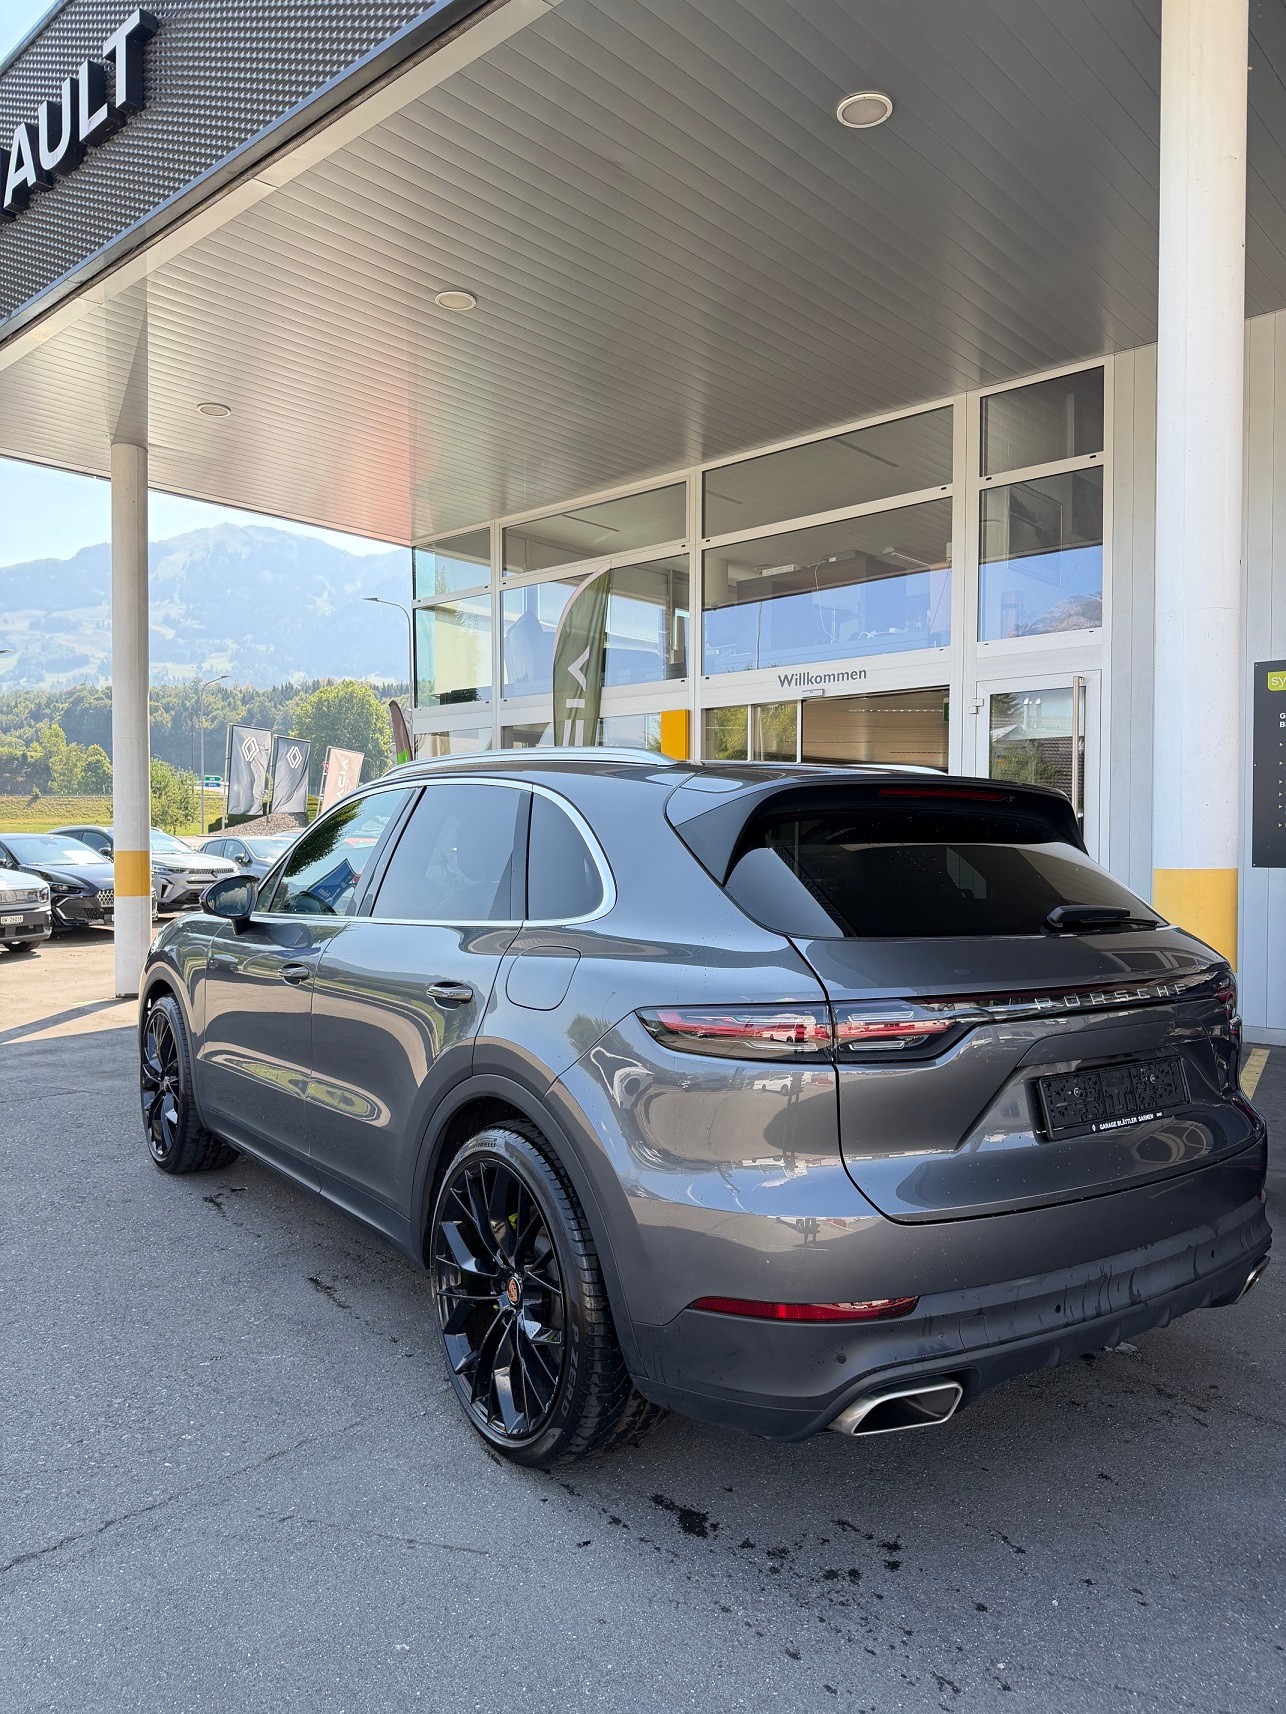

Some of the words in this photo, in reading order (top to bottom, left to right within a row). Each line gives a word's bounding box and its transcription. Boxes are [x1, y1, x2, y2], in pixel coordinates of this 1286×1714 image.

[3, 8, 142, 209] AULT
[777, 669, 867, 688] Willkommen
[1034, 983, 1188, 1010] PORSCHE
[1099, 1120, 1118, 1131] GARAGE
